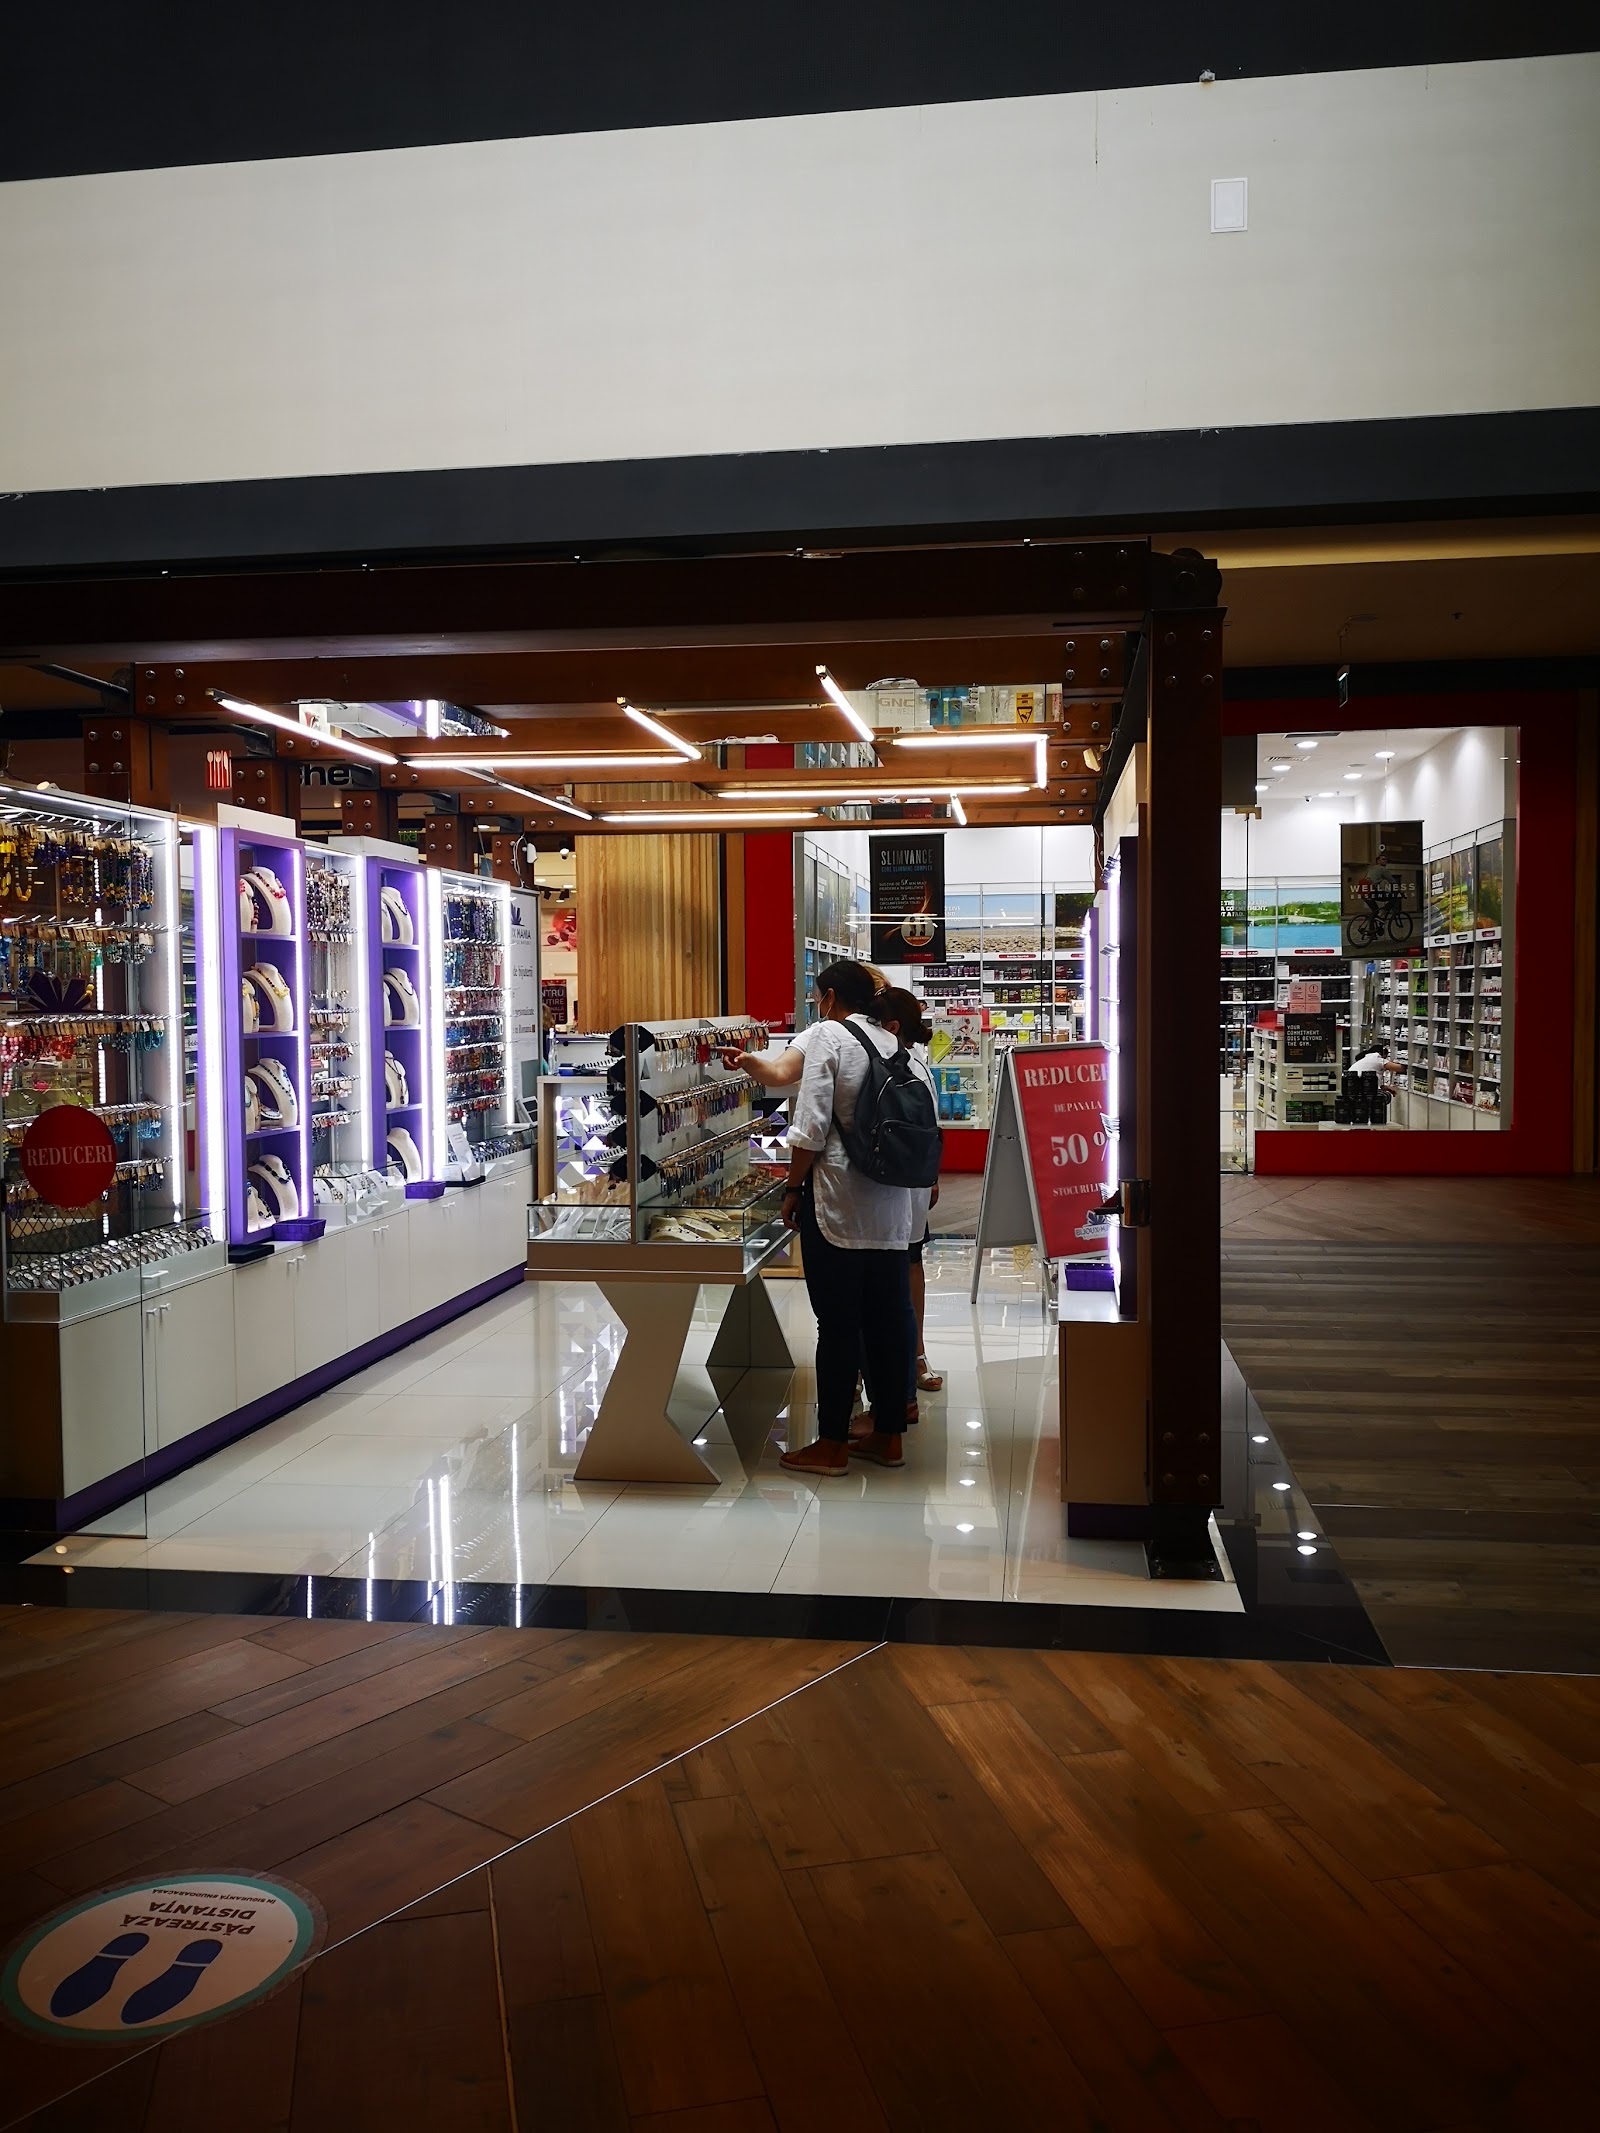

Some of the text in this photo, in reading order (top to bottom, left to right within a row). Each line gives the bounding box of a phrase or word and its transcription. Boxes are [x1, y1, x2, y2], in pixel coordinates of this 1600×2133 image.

[881, 848, 933, 866] SLIMVANCE
[1349, 882, 1416, 893] WELLNESS
[1350, 892, 1416, 900] ESSENTIALS
[542, 988, 564, 997] NTRU
[1024, 1061, 1109, 1088] REDUCE
[26, 1144, 114, 1167] REDUCERI
[1050, 1133, 1089, 1167] 50
[1076, 1224, 1107, 1237] BIJOUX-M
[149, 1901, 257, 1920] DISTANȚA
[119, 1914, 257, 1936] PĂSTREAZĂ
